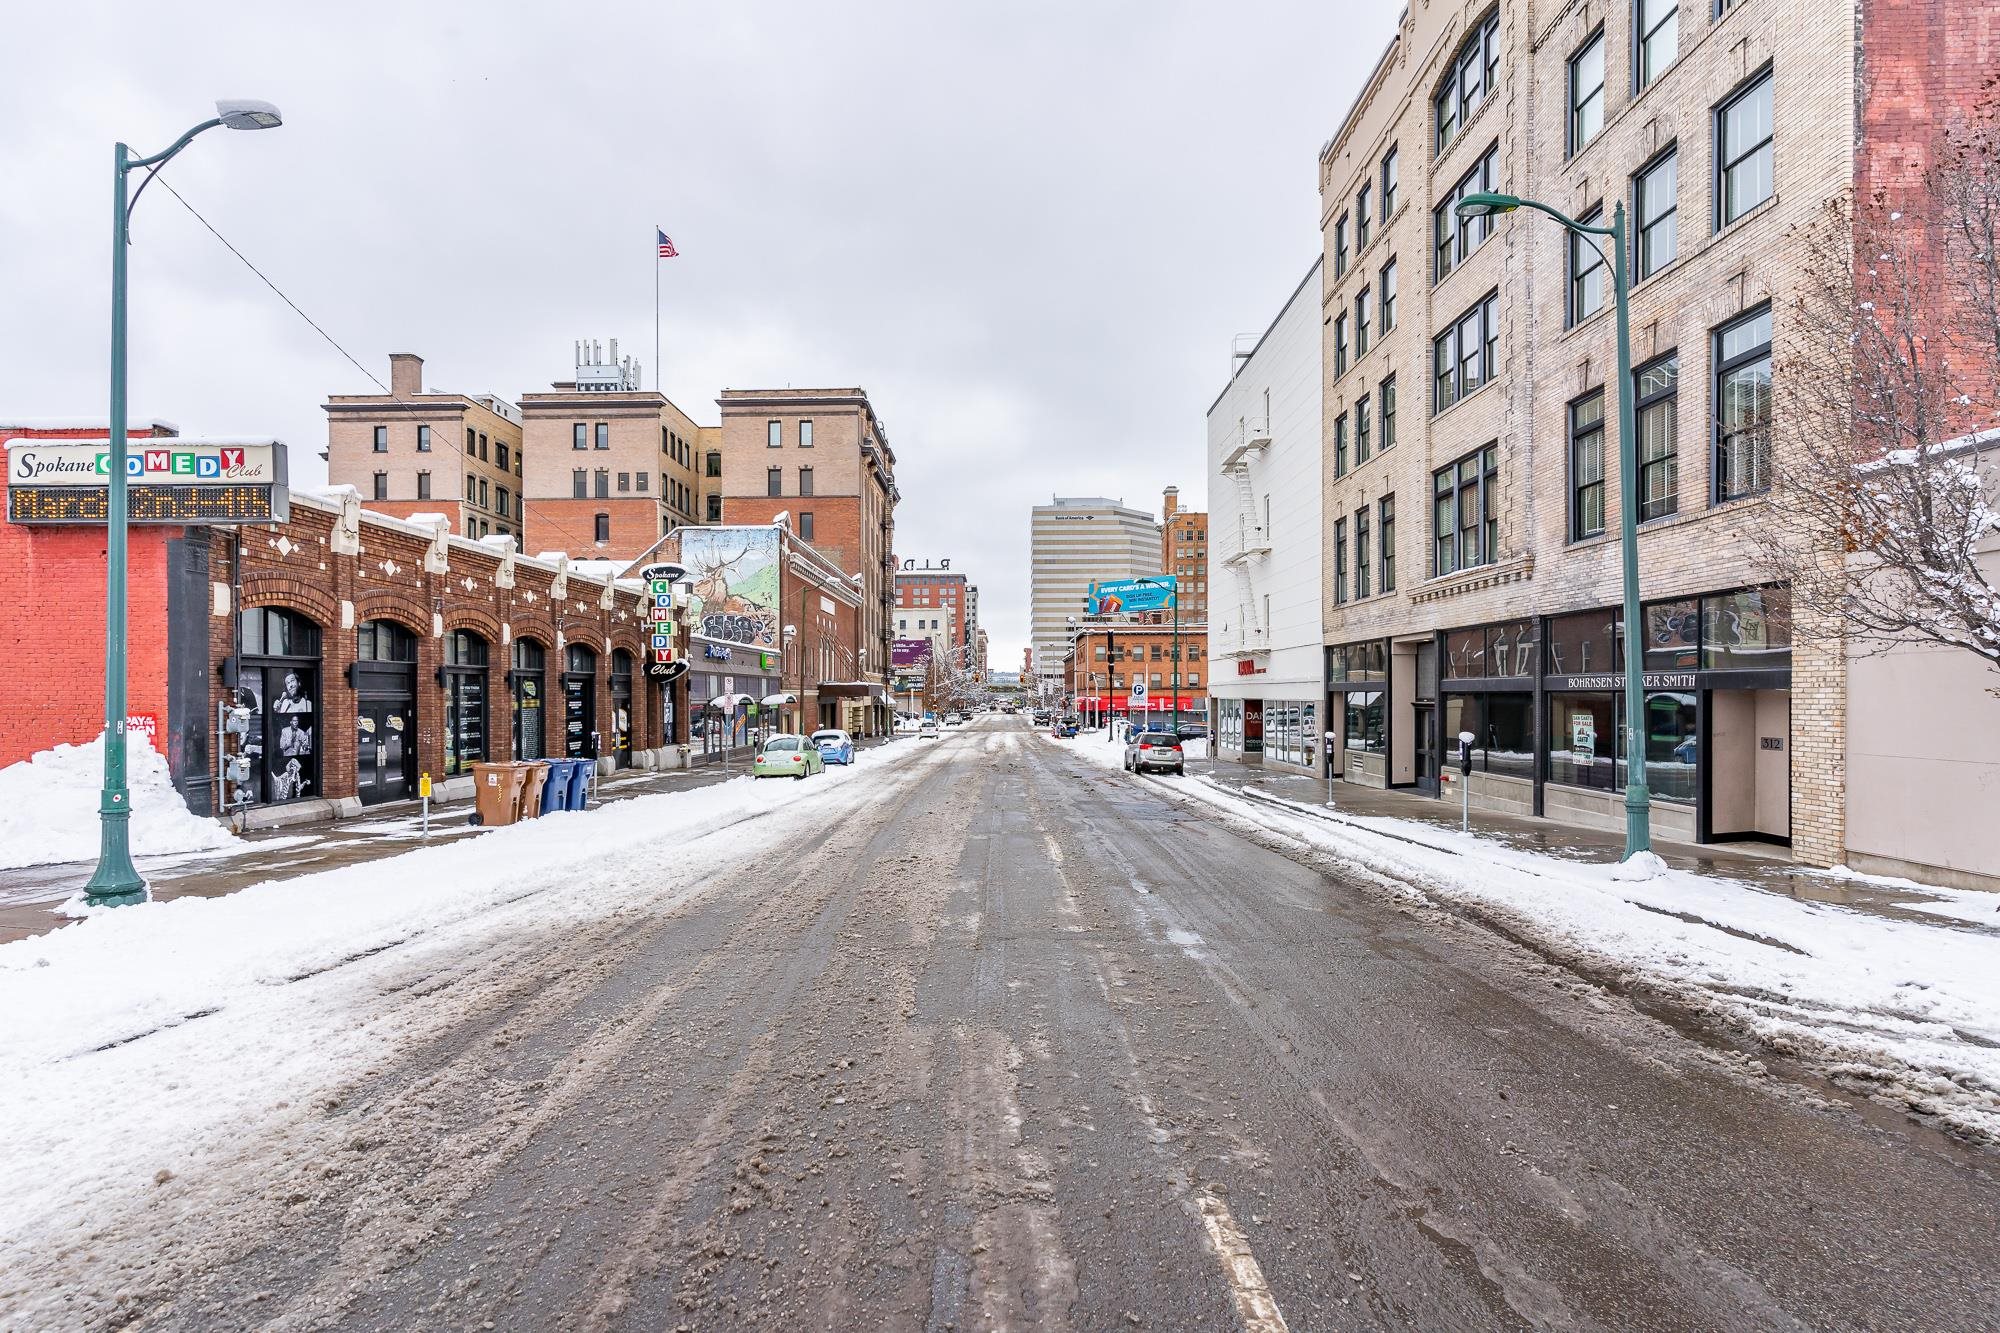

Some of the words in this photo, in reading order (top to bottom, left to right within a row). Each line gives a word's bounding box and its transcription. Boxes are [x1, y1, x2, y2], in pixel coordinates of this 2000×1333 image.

[17, 453, 94, 478] Spokane
[99, 450, 241, 475] COMEDY
[226, 462, 263, 478] Club
[647, 568, 679, 580] Spokane
[654, 581, 671, 661] COMEDY
[650, 664, 676, 675] Club
[1568, 677, 1613, 688] BOHRNSEN
[1662, 675, 1696, 687] SMITH
[126, 716, 145, 725] PAY
[1762, 738, 1780, 749] 312
